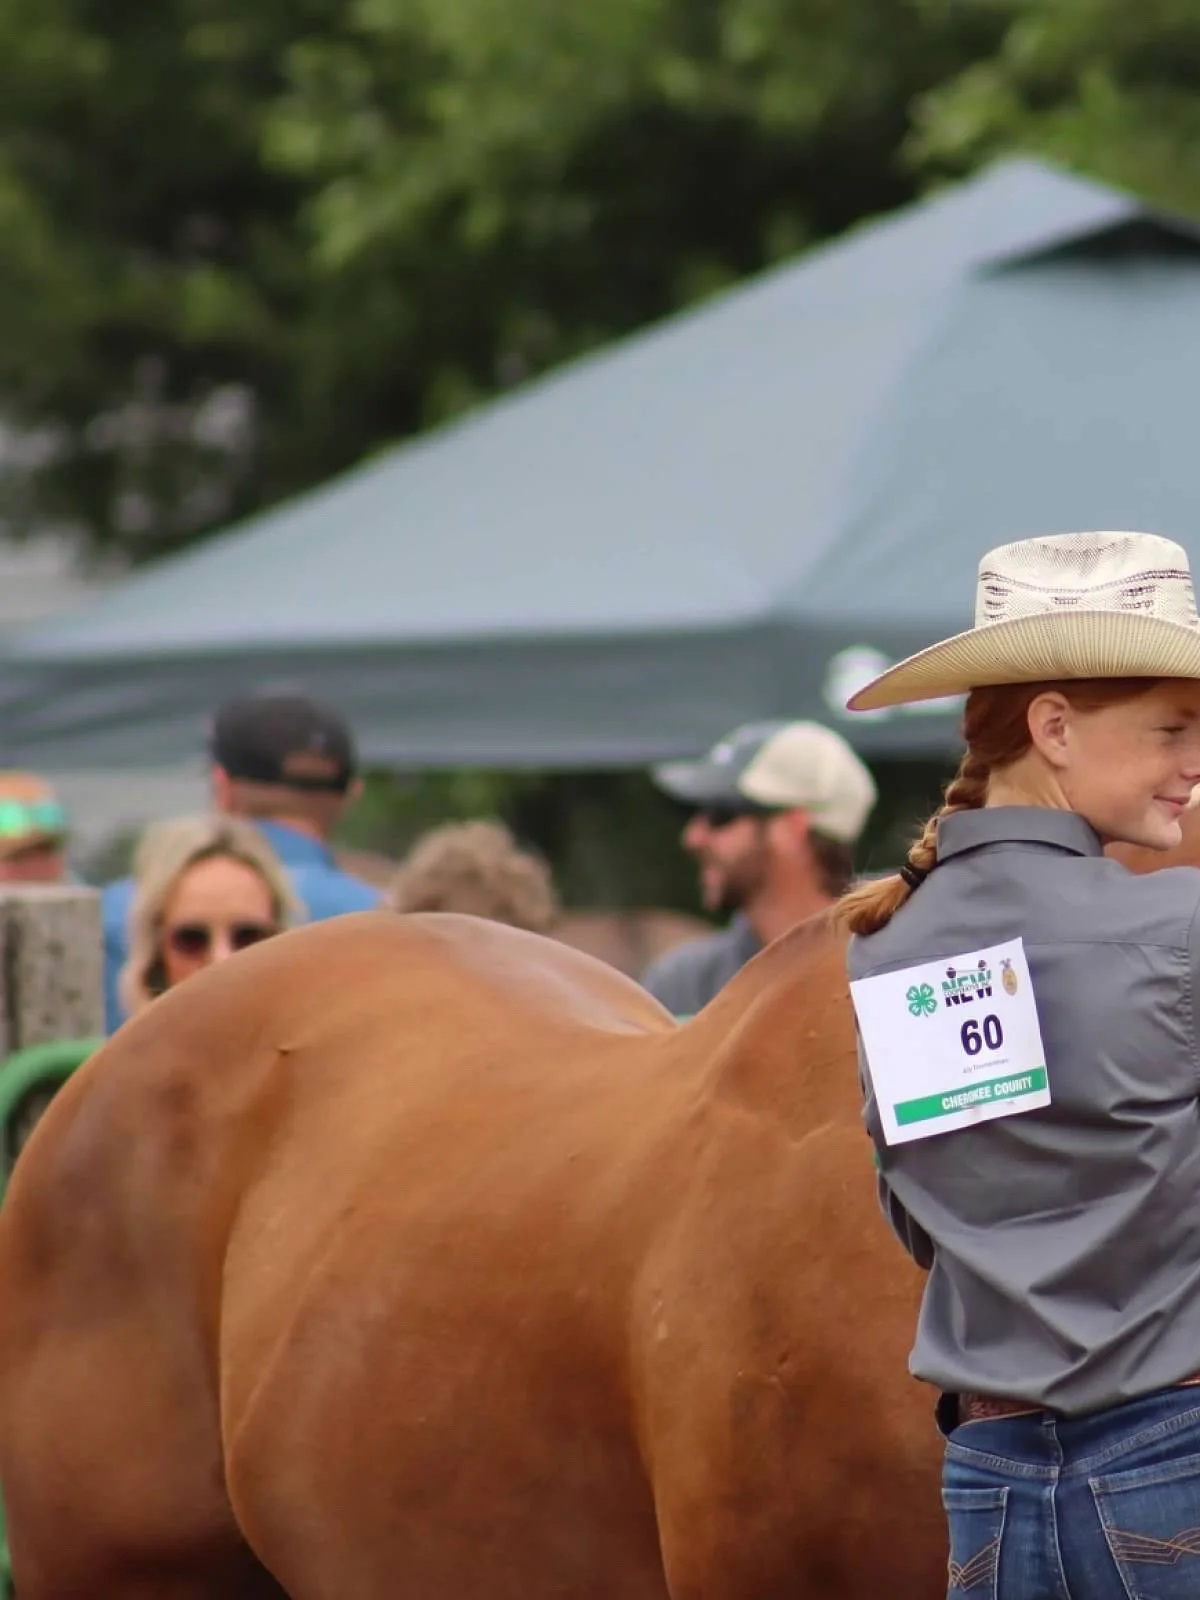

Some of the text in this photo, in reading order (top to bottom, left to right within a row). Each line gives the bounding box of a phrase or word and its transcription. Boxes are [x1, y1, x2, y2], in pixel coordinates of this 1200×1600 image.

[941, 969, 993, 1008] NEW
[960, 1014, 1004, 1056] 60
[941, 1076, 1033, 1110] CHEROKEE COUNTY
